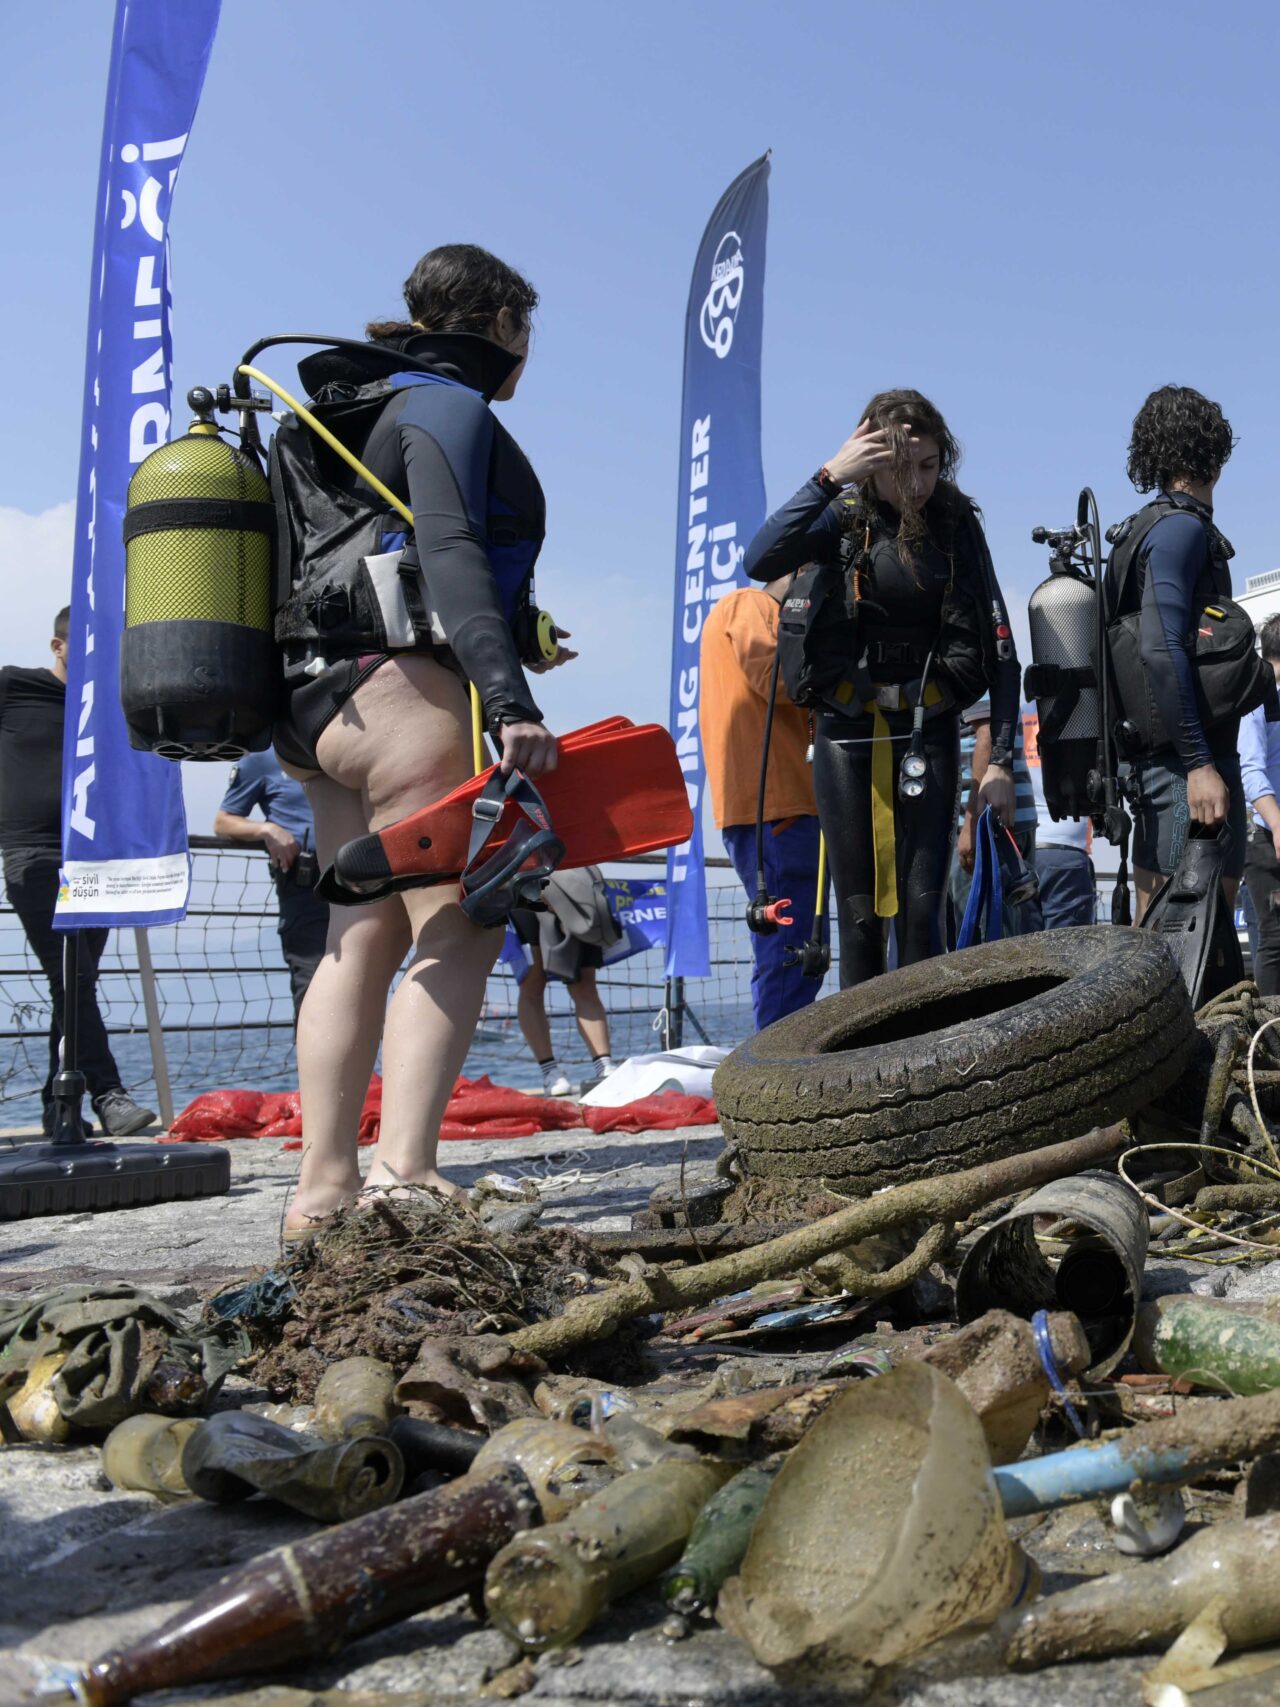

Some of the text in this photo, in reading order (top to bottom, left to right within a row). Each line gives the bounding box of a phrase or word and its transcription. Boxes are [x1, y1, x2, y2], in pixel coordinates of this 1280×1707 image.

[683, 413, 711, 645] CENTER
[82, 872, 99, 885] sivil
[72, 886, 99, 901] düşün
